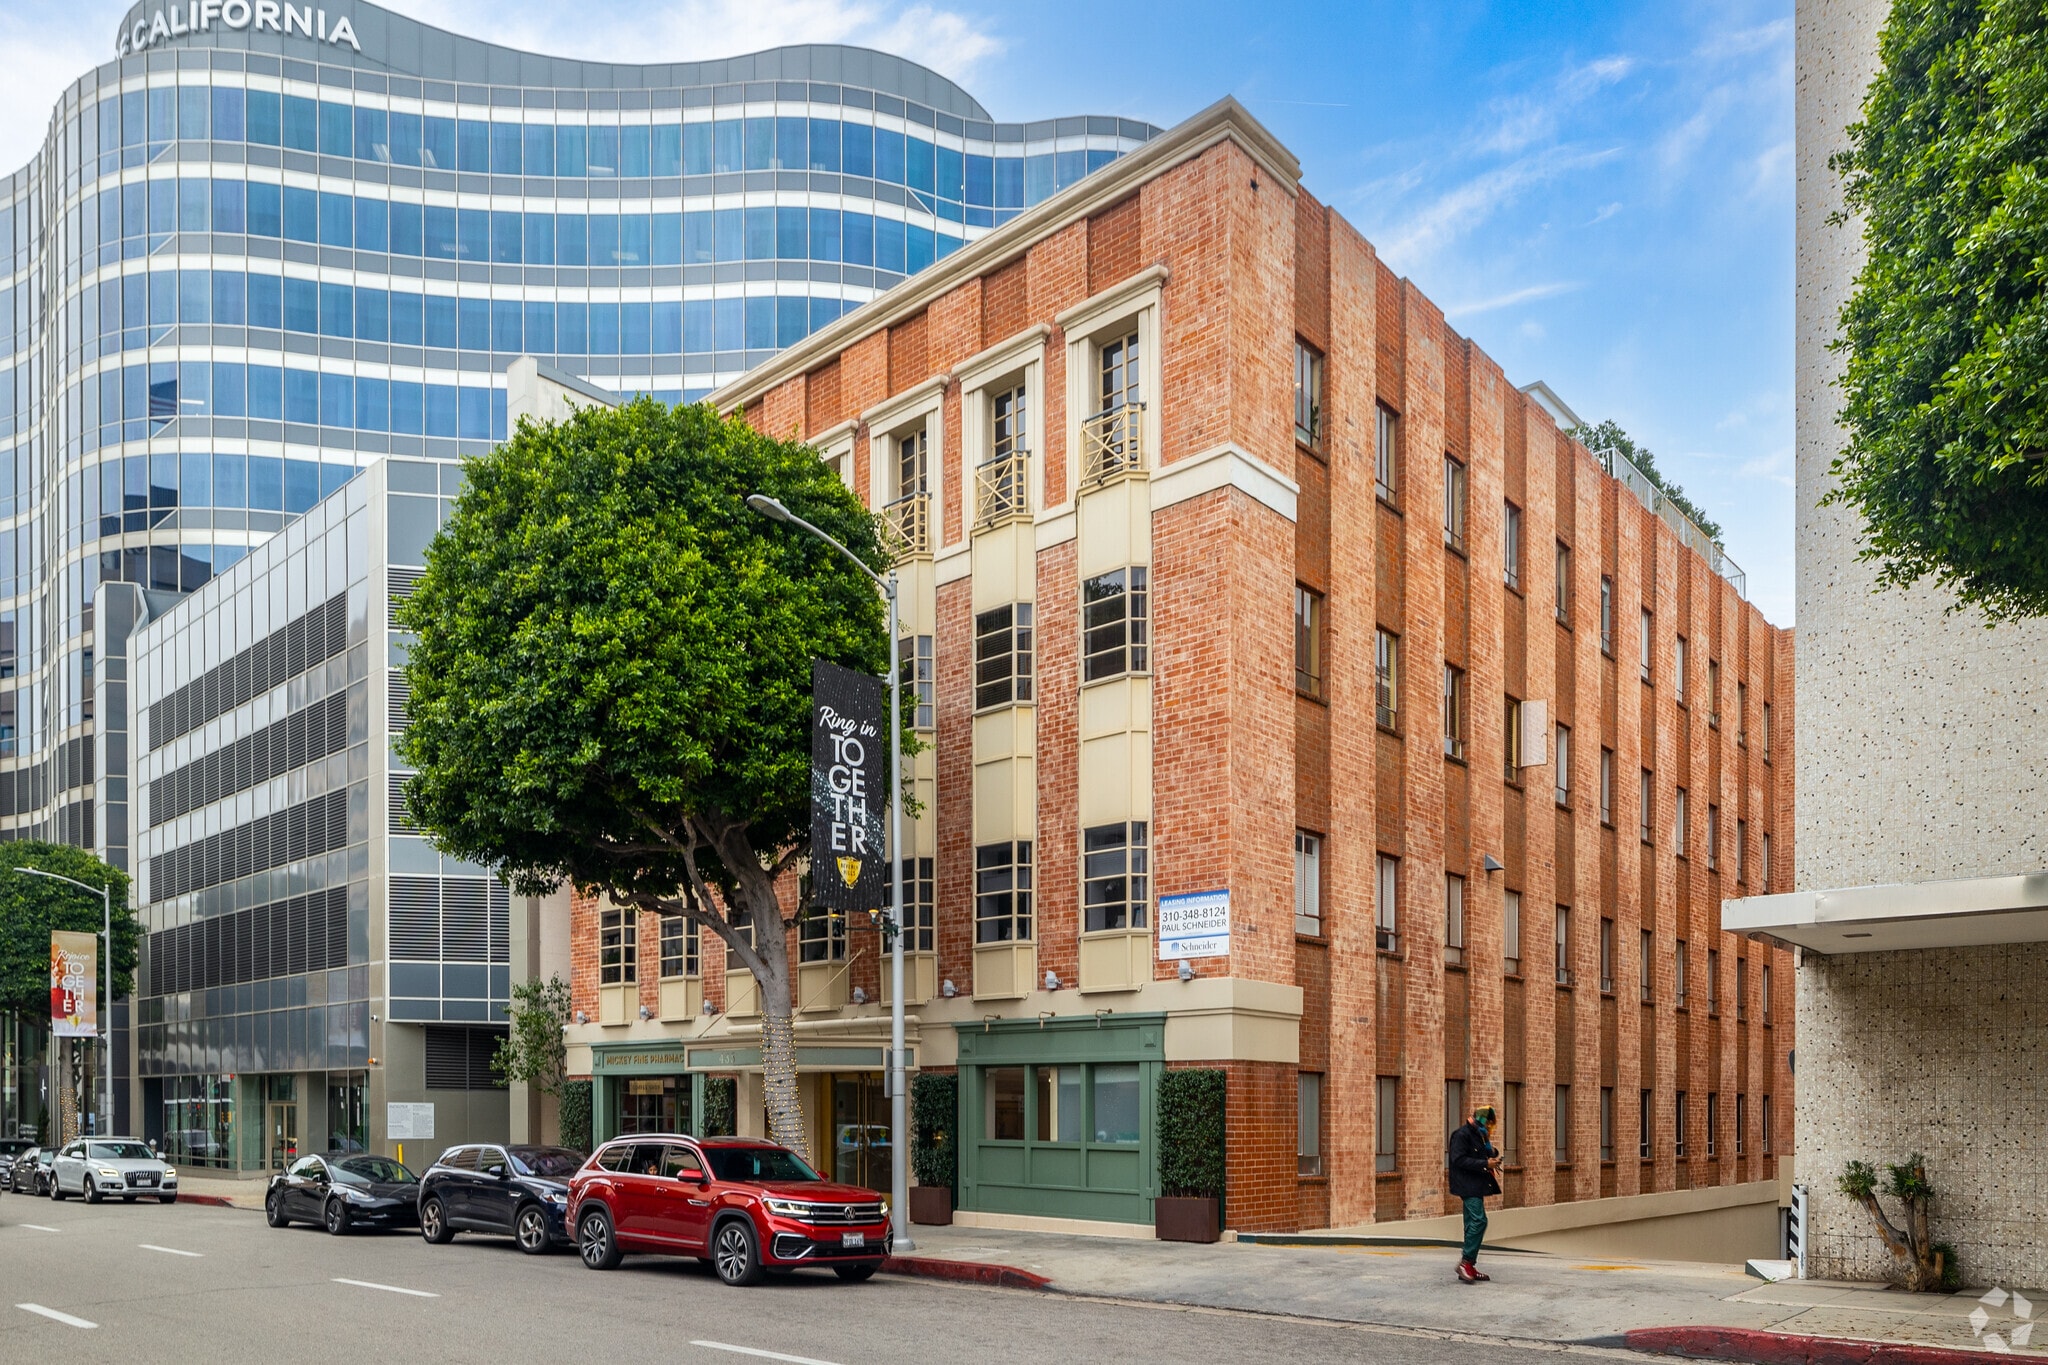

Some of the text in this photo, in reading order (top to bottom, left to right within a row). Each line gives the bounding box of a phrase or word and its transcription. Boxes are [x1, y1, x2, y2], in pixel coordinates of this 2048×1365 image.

[131, 0, 362, 51] CALIFORNIA
[819, 705, 877, 738] Ring in
[830, 733, 865, 767] TO
[828, 764, 866, 798] GE
[830, 793, 866, 826] TH
[831, 822, 867, 855] ER
[1161, 894, 1227, 906] LEASING INFORMATION
[1162, 906, 1226, 922] 310-348-8124
[1161, 919, 1227, 932] PAUL SCHNEIDER
[1181, 940, 1217, 952] Schneider
[606, 1055, 631, 1065] MICKEY
[633, 1054, 649, 1065] FINE
